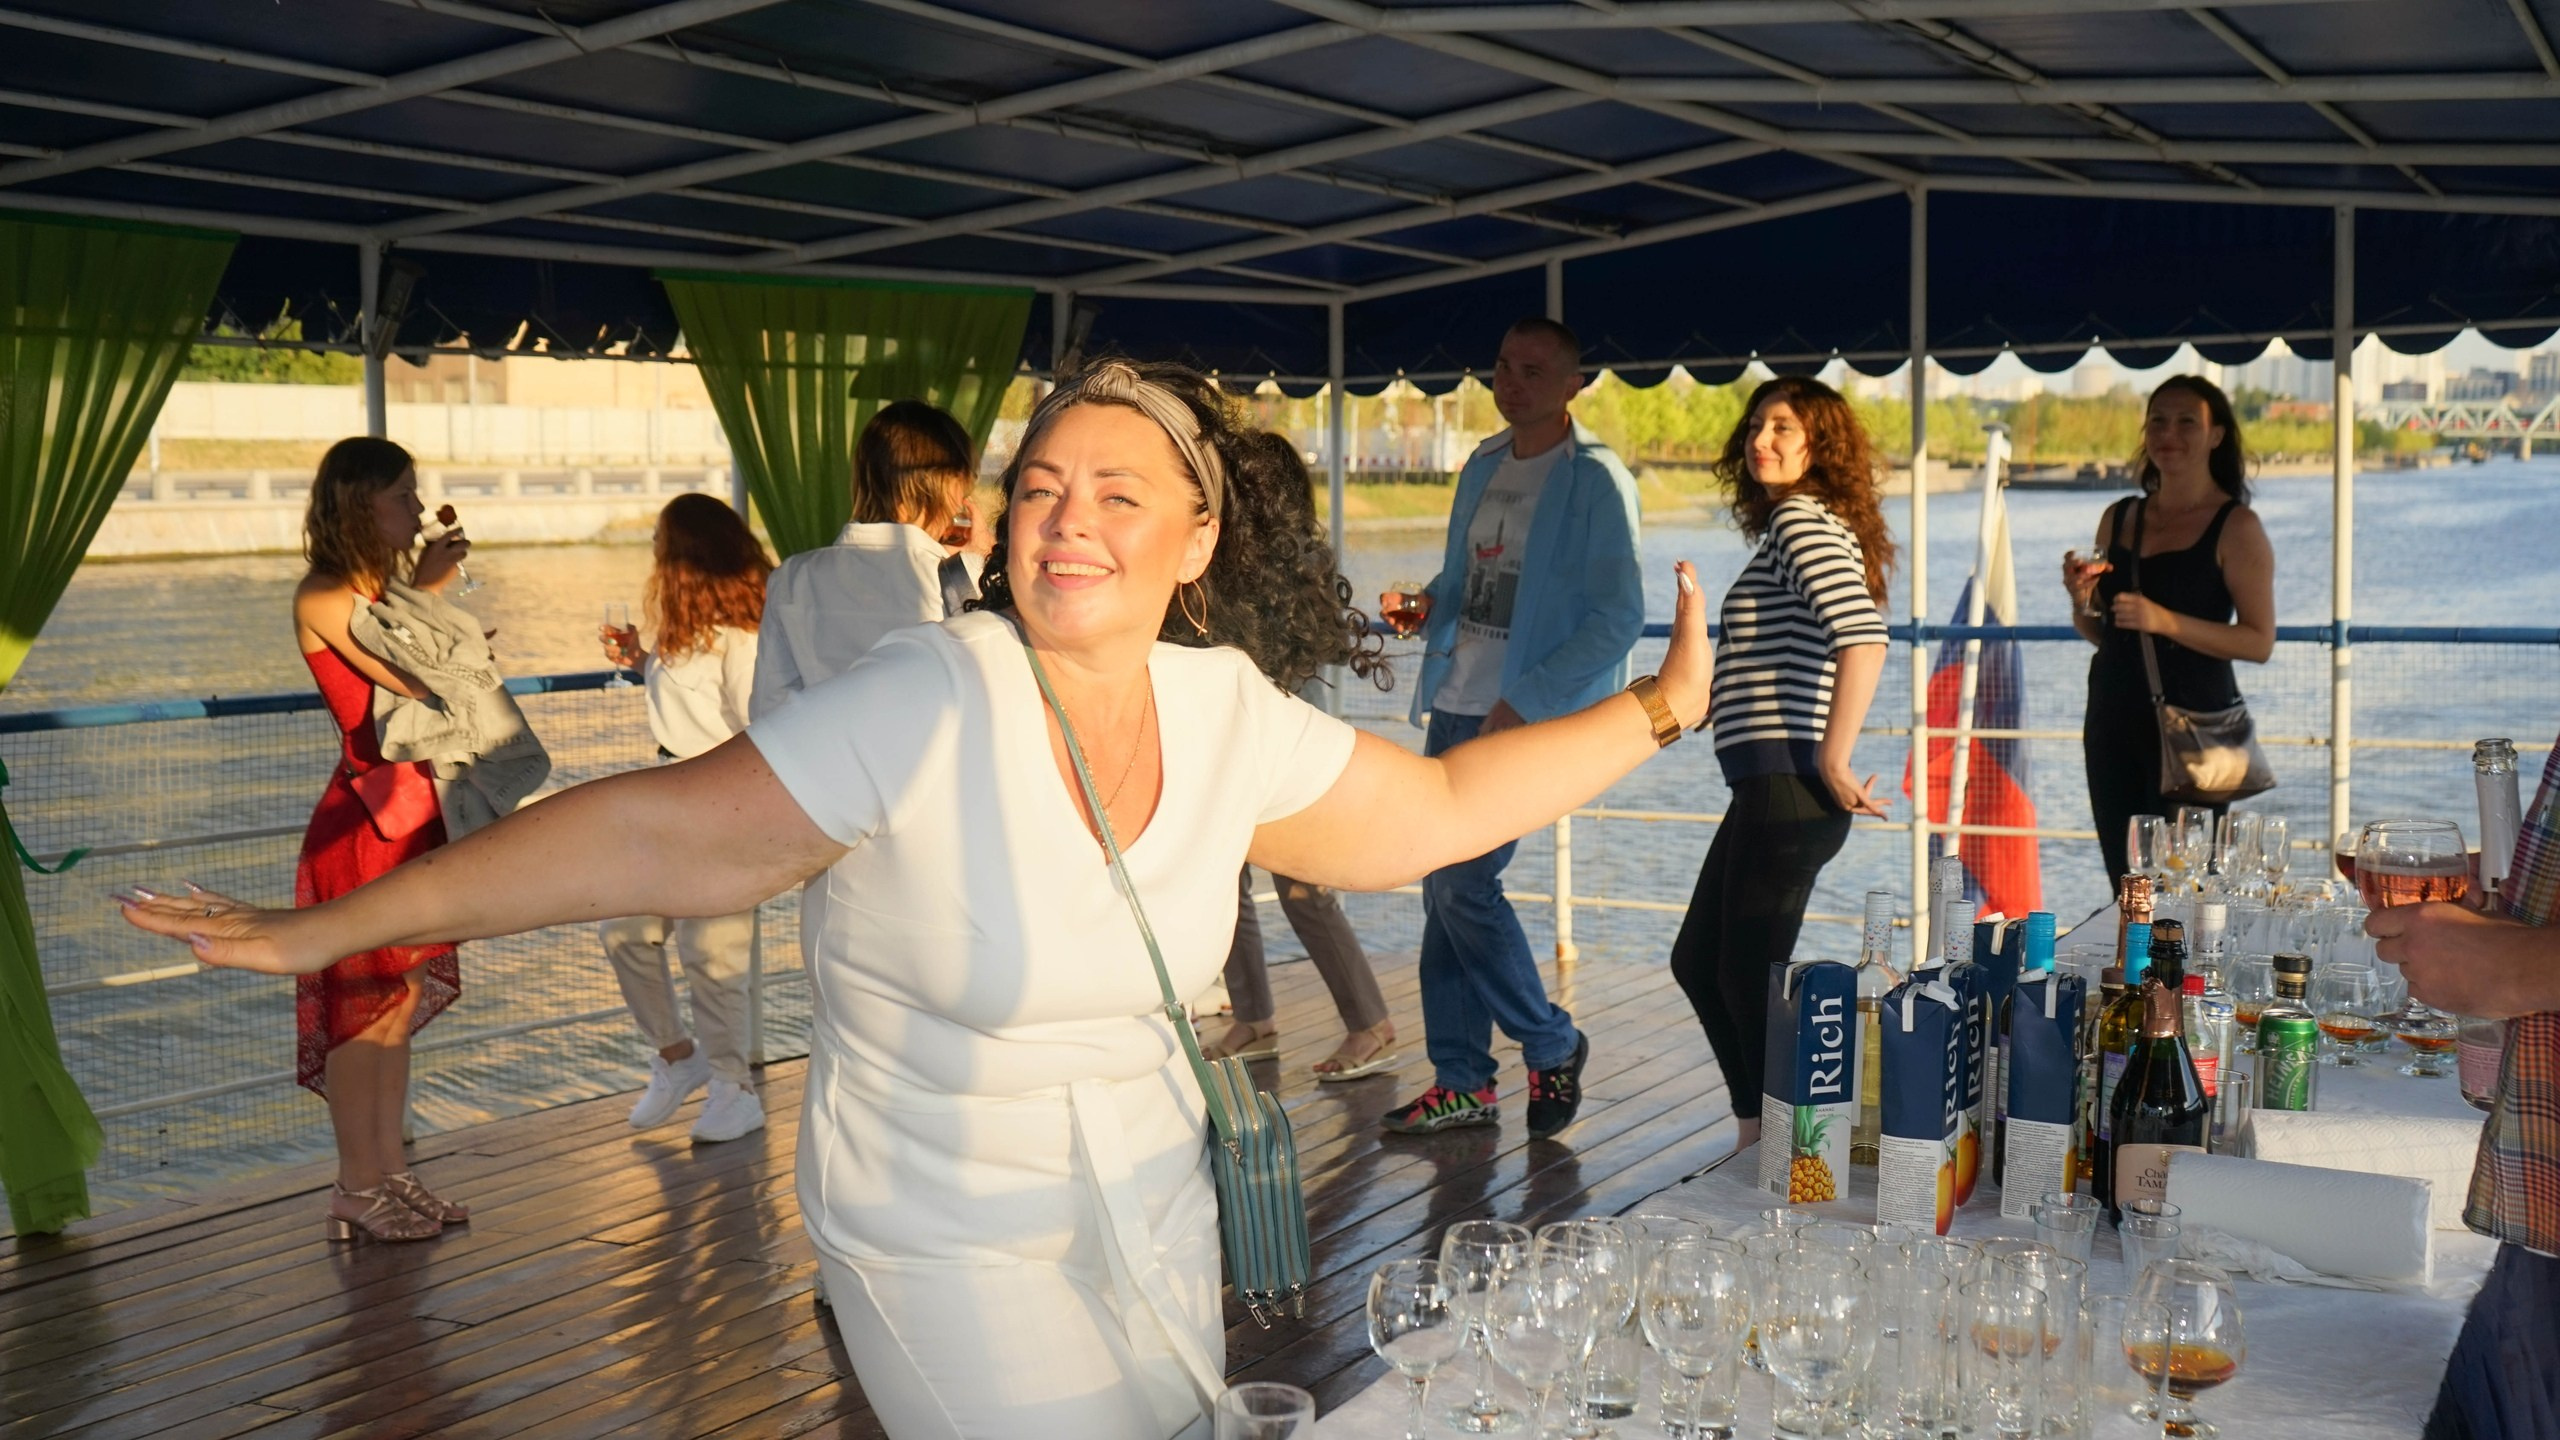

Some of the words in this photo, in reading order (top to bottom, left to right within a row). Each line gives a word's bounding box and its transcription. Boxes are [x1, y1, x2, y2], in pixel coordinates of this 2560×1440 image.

[1809, 995, 1844, 1098] Rich
[1945, 1019, 1962, 1127] Rich
[1966, 994, 1982, 1101] Rich
